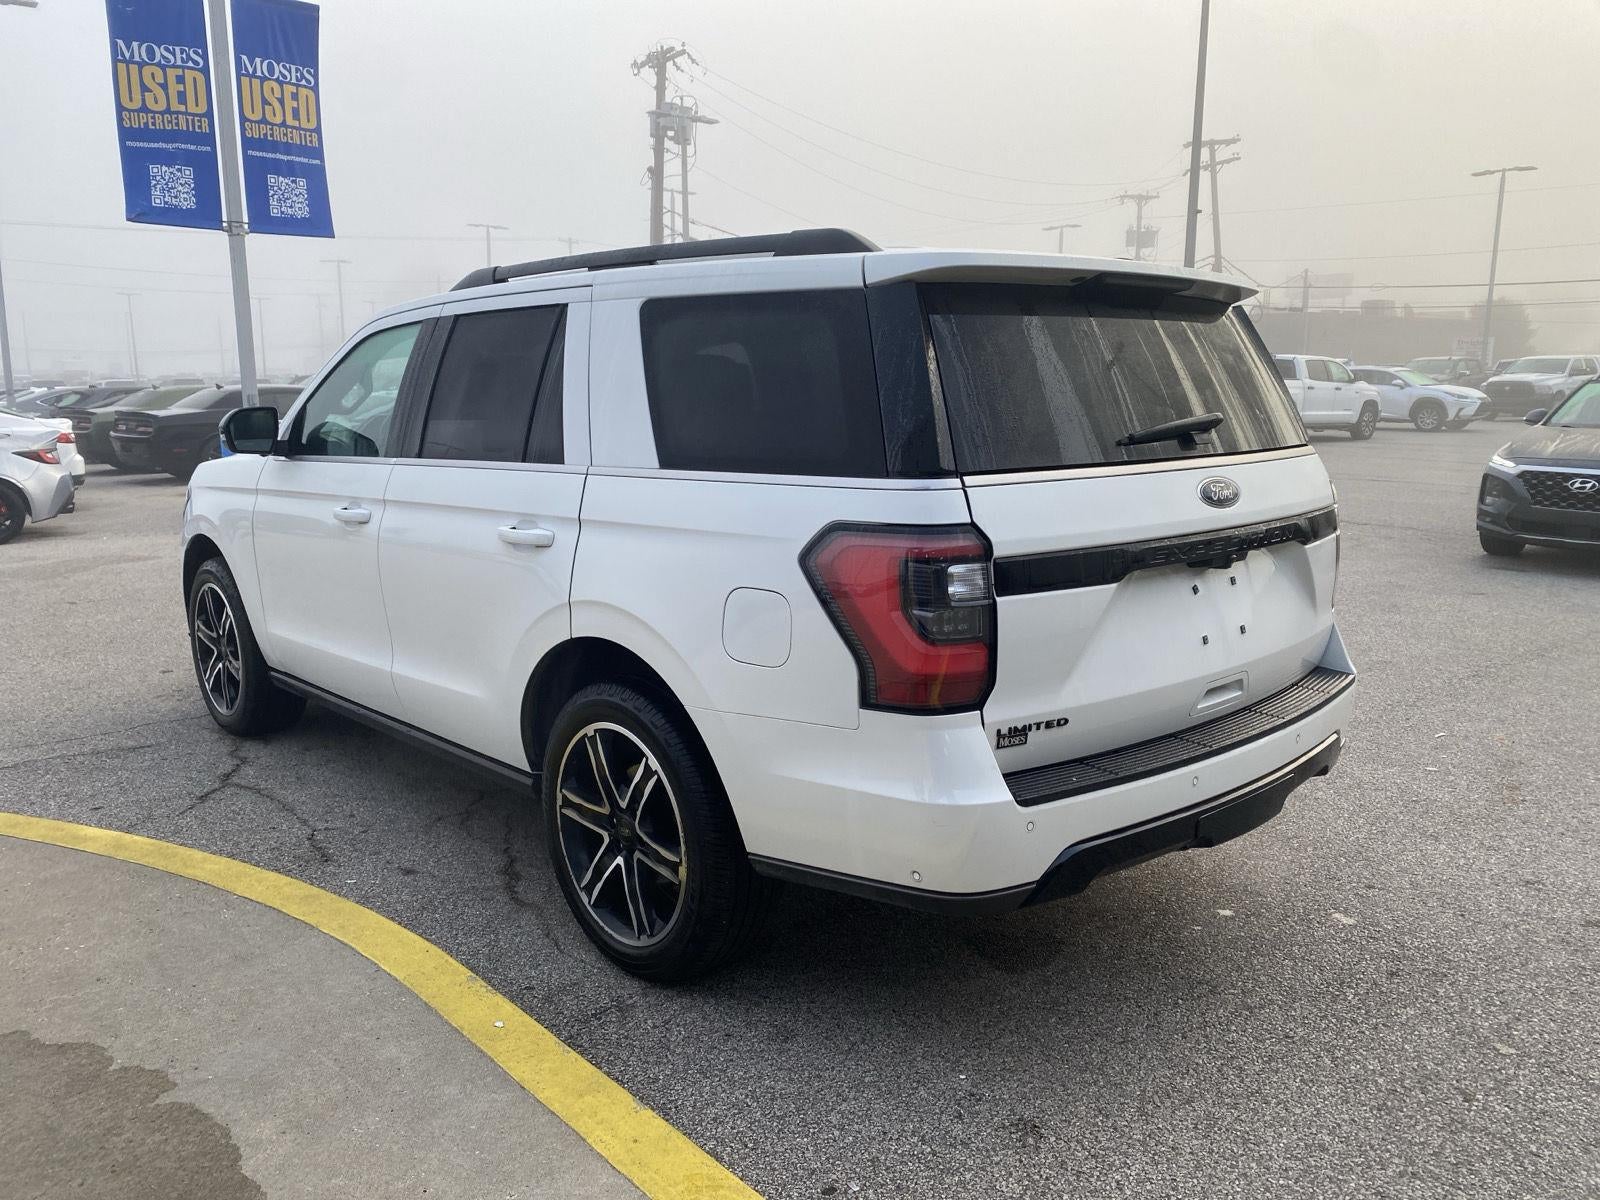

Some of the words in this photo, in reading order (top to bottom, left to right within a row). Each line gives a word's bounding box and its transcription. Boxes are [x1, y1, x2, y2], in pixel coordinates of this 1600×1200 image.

[115, 39, 204, 69] MOSES
[239, 54, 315, 87] MOSES
[117, 63, 208, 114] USED
[241, 76, 317, 130] USED
[122, 111, 209, 134] SUPERCENTER
[244, 121, 319, 148] SUPERCENTER
[125, 140, 212, 152] mosesusedsupercenter.com
[1210, 482, 1234, 501] Ford
[996, 716, 1070, 737] LIMITED
[998, 735, 1027, 748] MOSES
